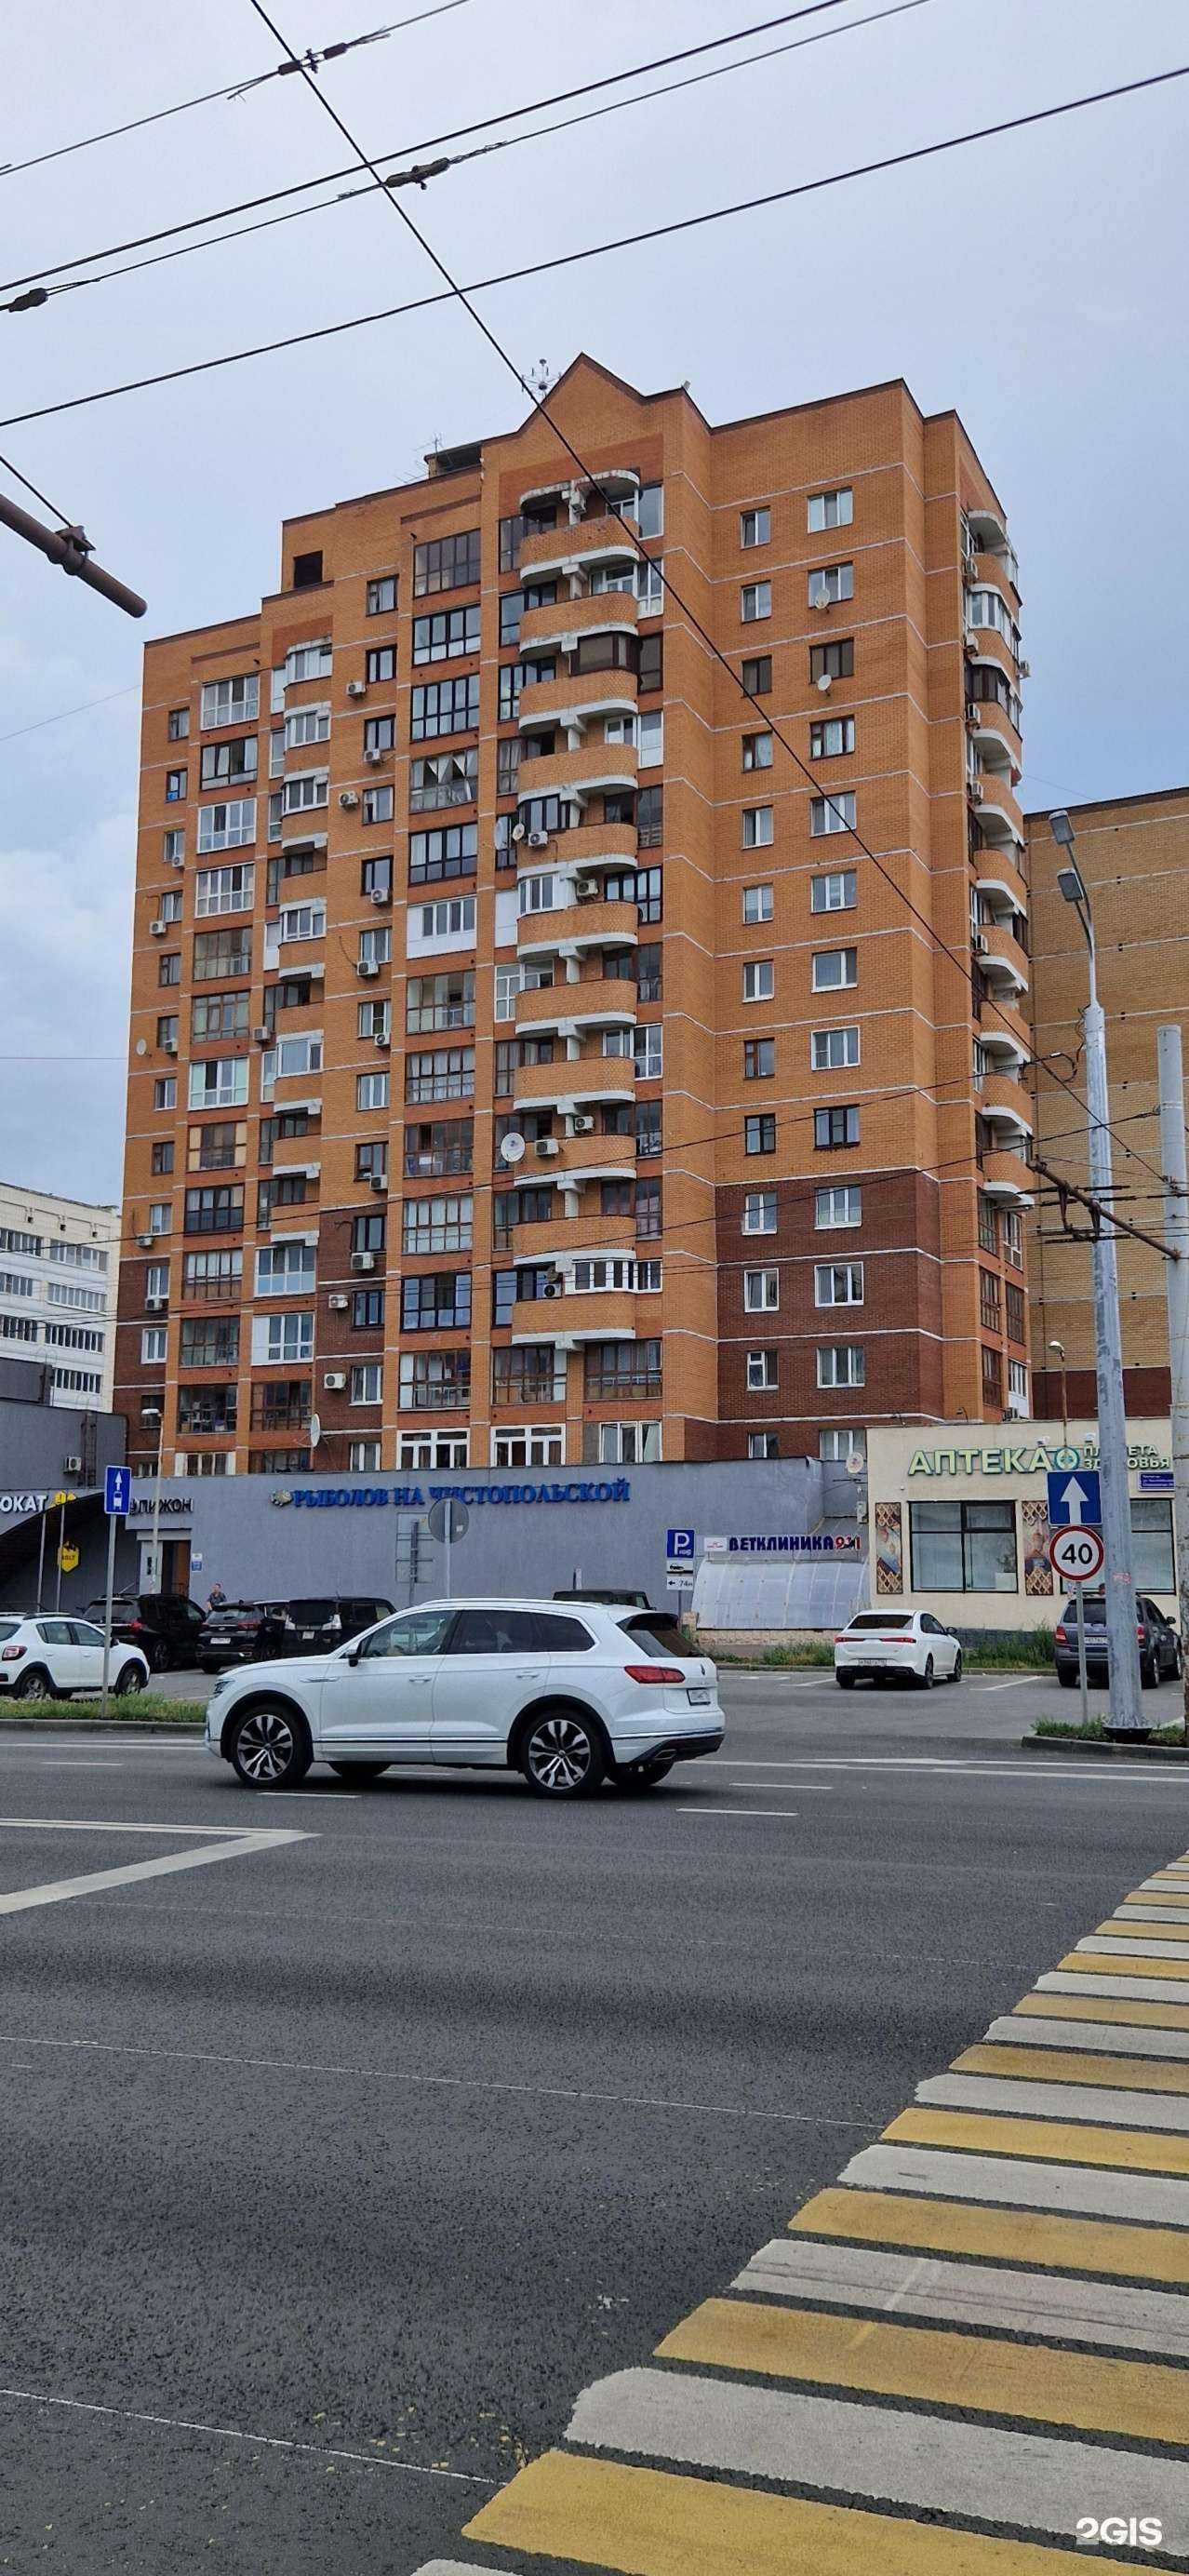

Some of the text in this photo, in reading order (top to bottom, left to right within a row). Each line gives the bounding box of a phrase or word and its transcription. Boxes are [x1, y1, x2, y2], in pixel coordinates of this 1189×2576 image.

[1083, 1444, 1157, 1457] ПЛЕТА
[908, 1447, 1053, 1476] АПТЕКА
[1083, 1457, 1170, 1469] ЗДОВЬЯ
[292, 1489, 388, 1508] РЫБОЛОВ
[394, 1487, 425, 1506] НА
[728, 1536, 834, 1551] ВЕТКЛИНИКА
[1061, 1543, 1093, 1565] 40
